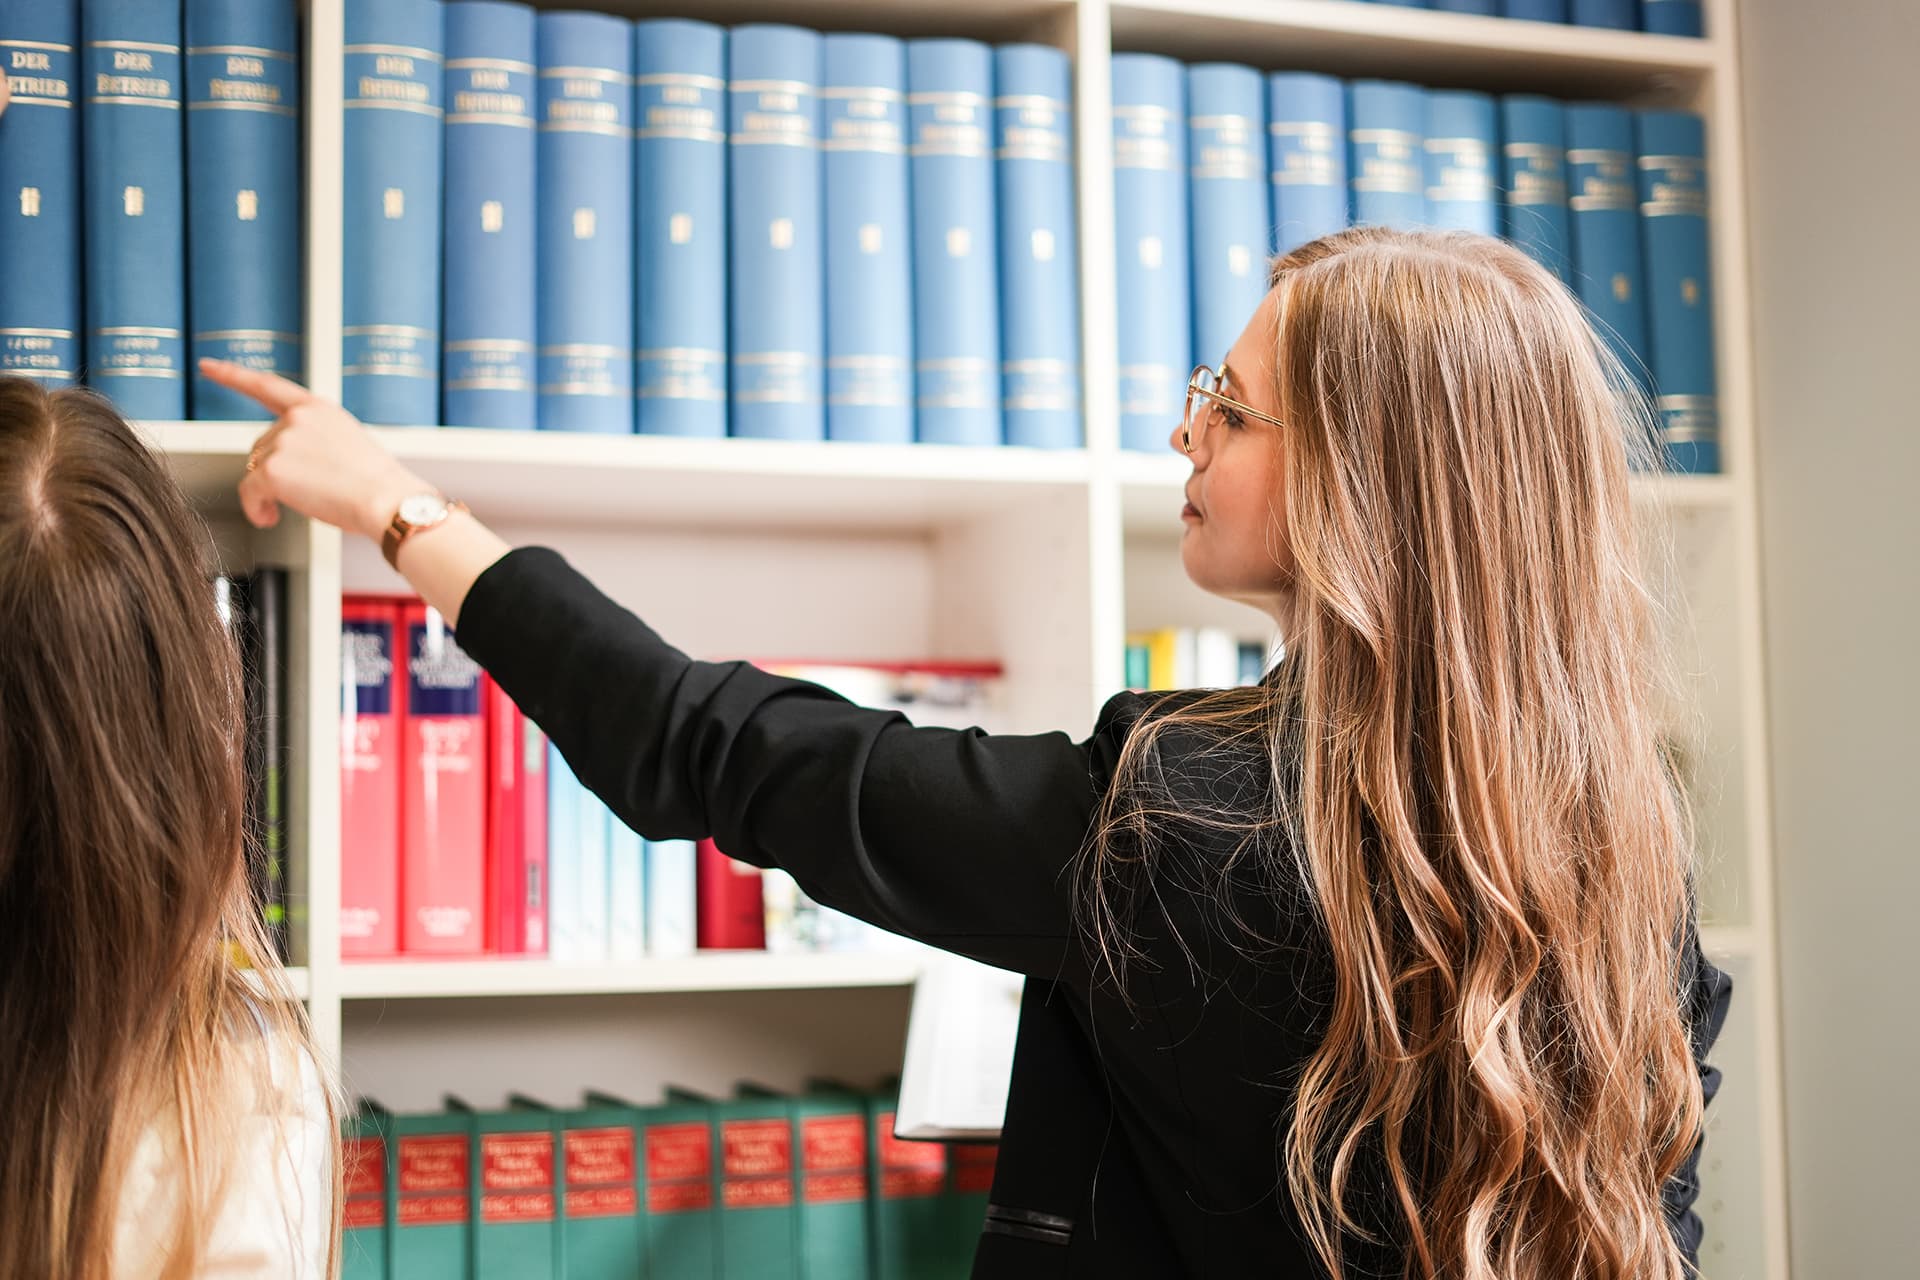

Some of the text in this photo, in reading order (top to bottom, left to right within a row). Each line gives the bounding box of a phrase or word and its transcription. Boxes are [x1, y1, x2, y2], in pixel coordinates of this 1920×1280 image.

[12, 51, 50, 71] DER
[114, 51, 152, 72] DER
[8, 75, 69, 97] ETRIEB
